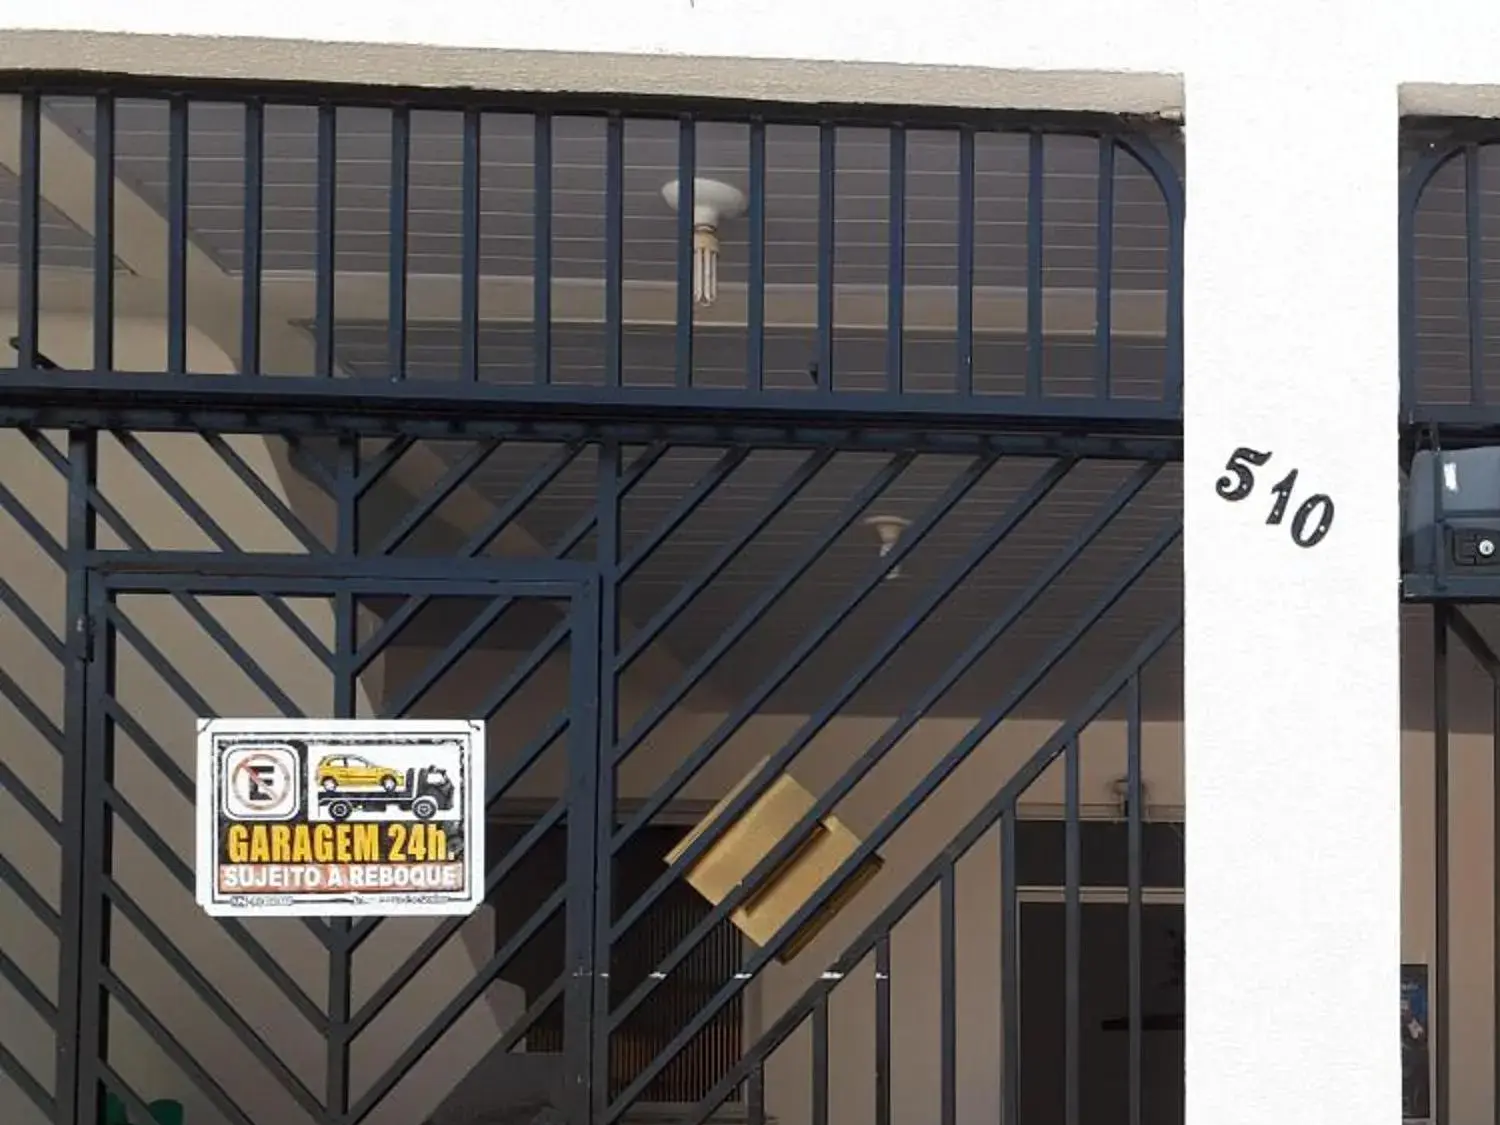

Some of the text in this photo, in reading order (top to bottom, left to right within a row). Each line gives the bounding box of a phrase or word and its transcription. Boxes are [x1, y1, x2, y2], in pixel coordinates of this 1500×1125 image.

[1215, 447, 1335, 548] 510
[228, 824, 379, 863] GARAGEM
[224, 866, 319, 888] SUJEITO
[349, 865, 455, 888] REBOQUE
